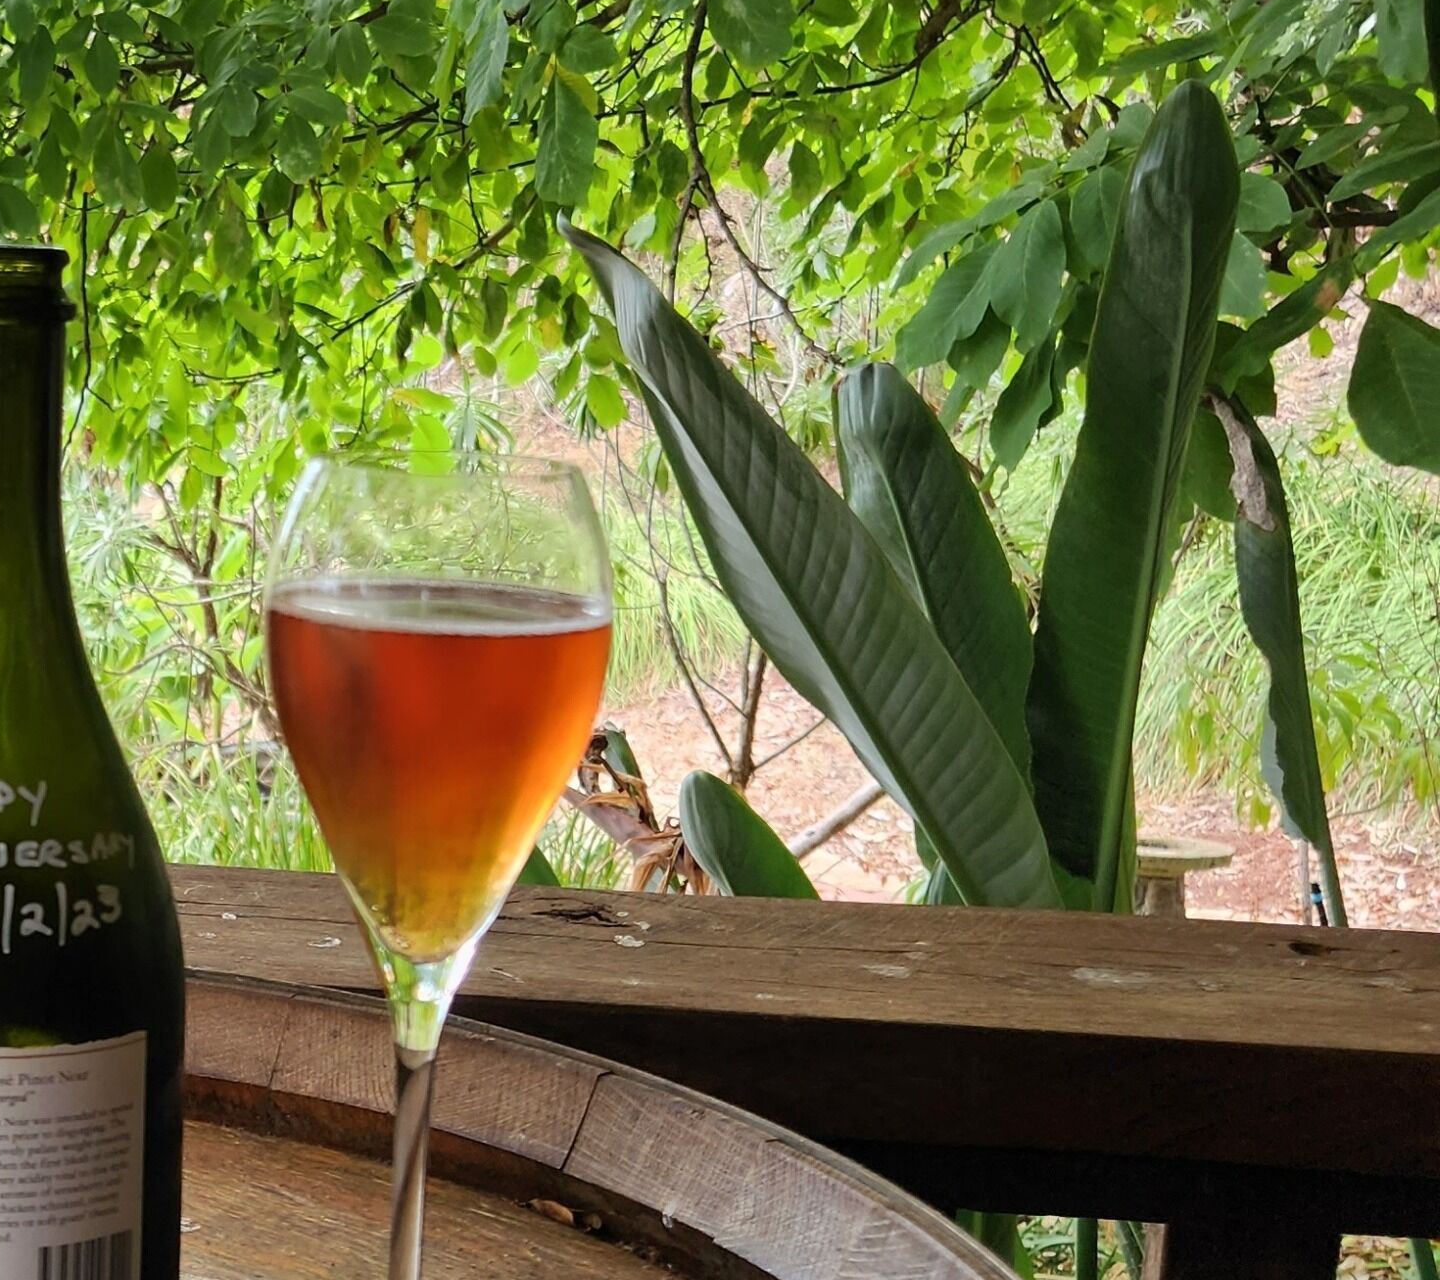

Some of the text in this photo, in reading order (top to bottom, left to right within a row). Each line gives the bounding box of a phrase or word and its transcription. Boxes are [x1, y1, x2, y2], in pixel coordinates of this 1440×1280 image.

[17, 1073, 54, 1086] Pinot
[59, 1070, 88, 1083] Noir
[4, 1117, 28, 1126] Noir
